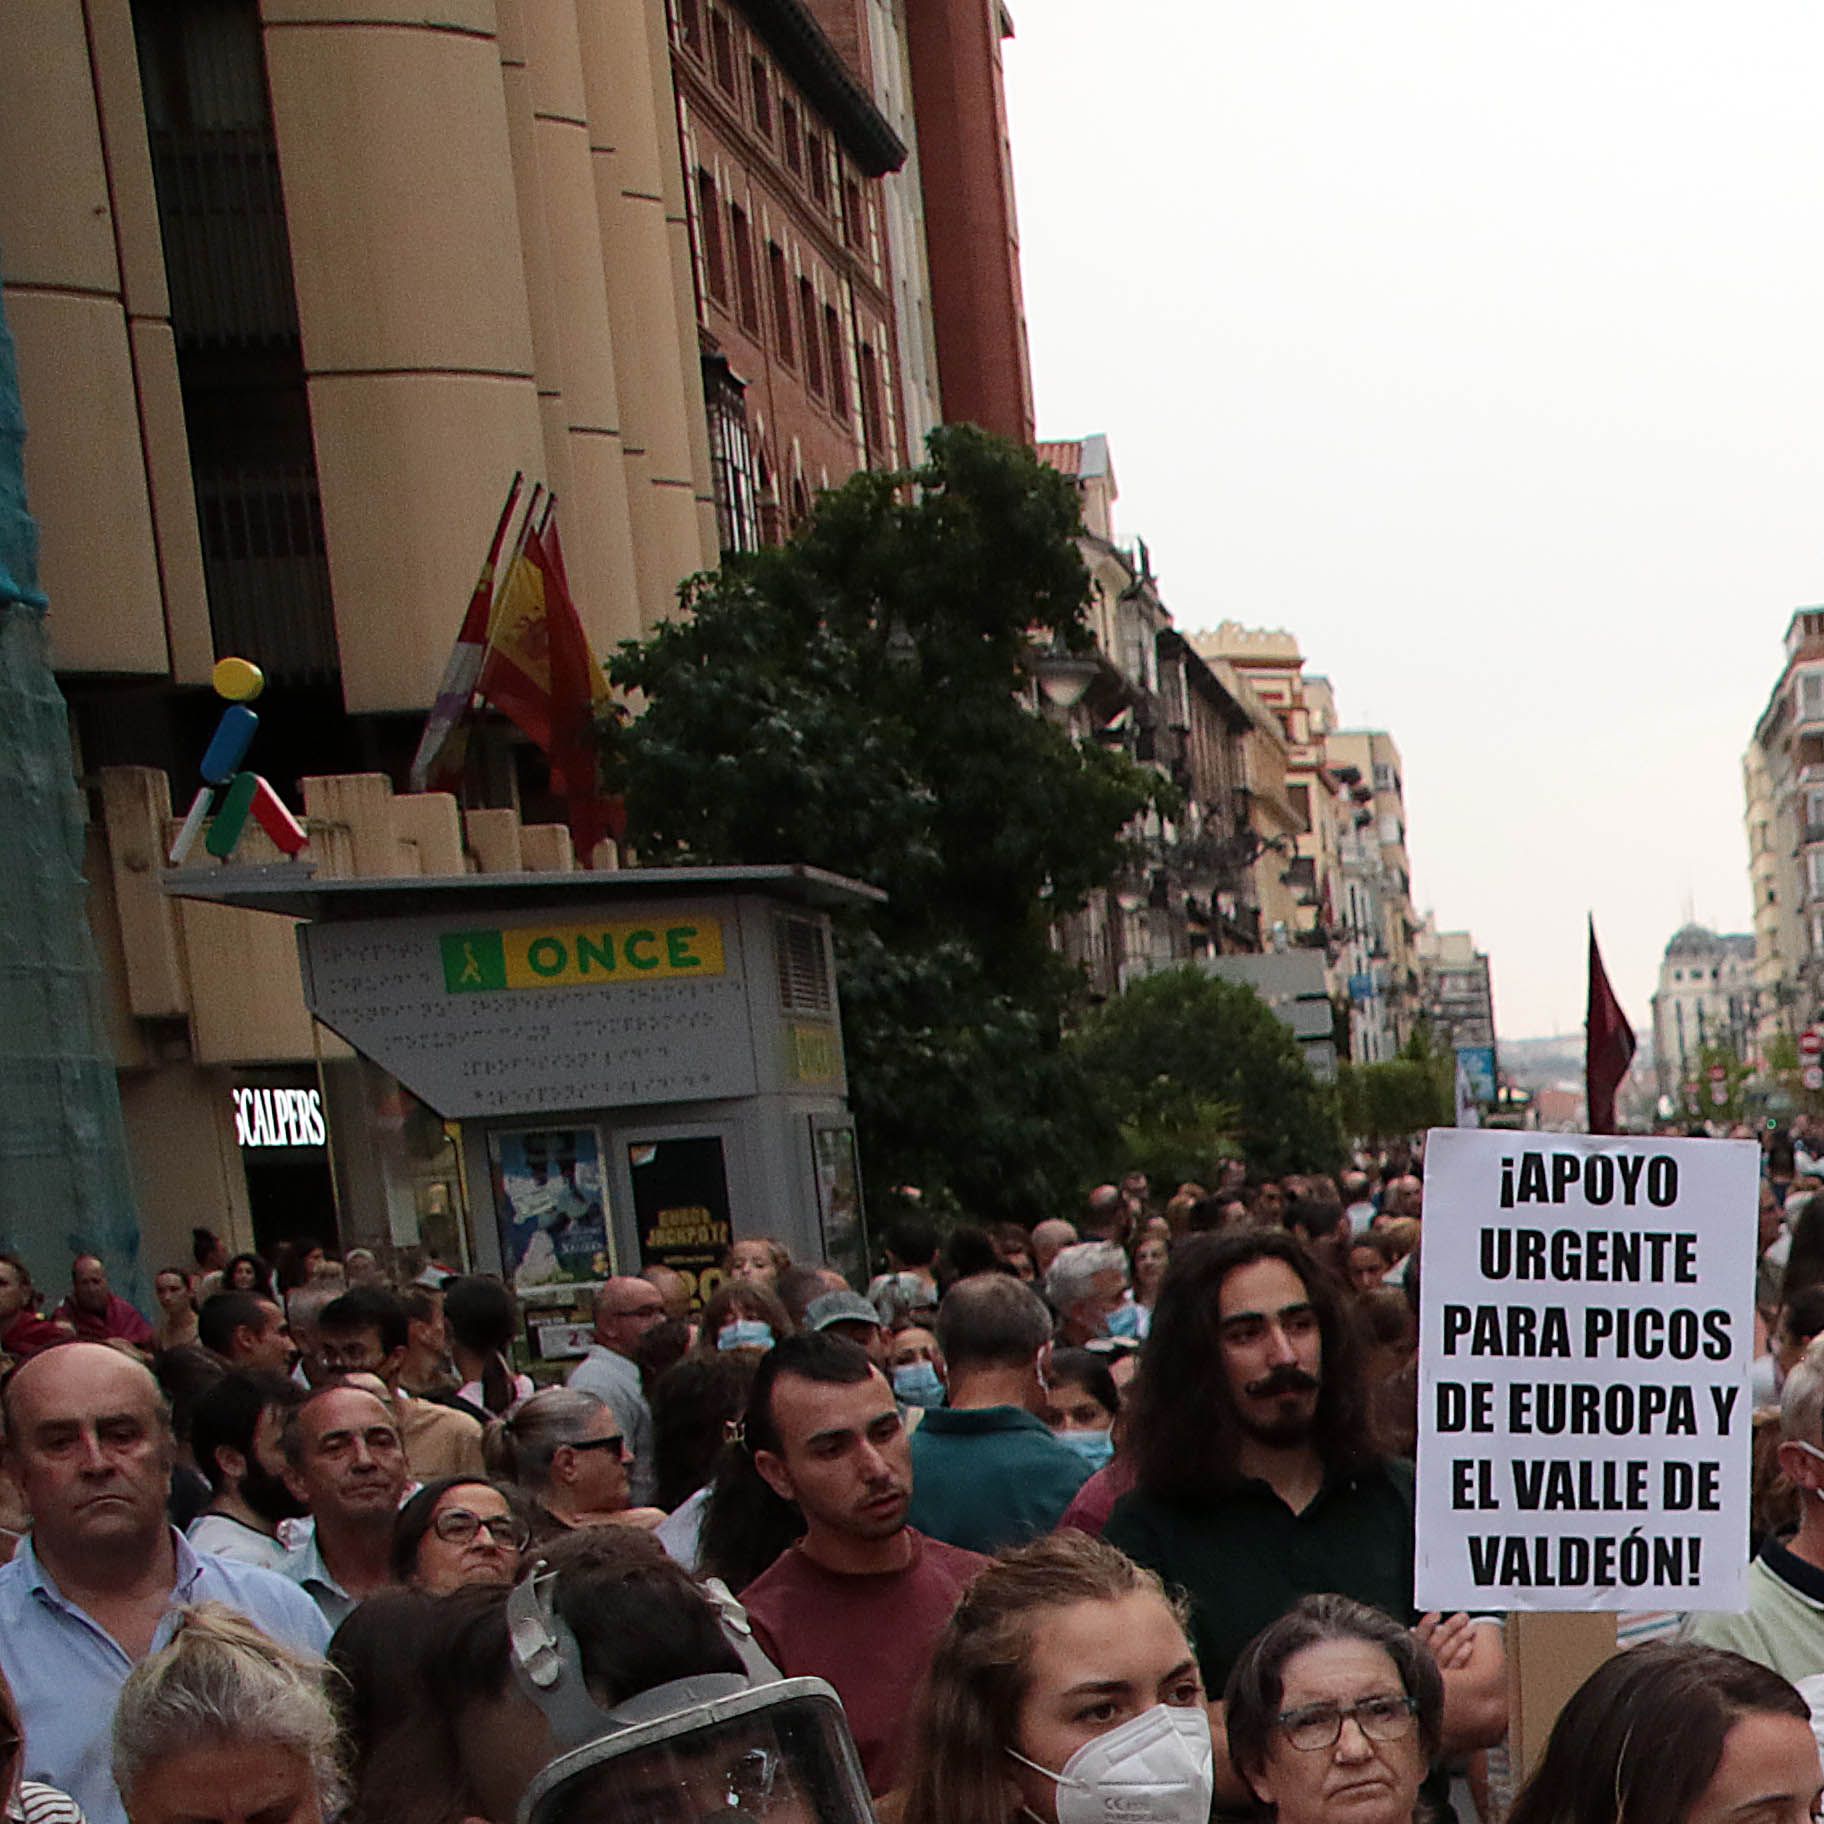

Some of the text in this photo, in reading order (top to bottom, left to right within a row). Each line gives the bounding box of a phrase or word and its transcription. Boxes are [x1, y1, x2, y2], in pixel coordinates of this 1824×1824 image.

[527, 926, 702, 977] ONCE
[1500, 1152, 1679, 1209] ¡APOYO
[1480, 1227, 1698, 1283] URGENTE
[1442, 1304, 1732, 1360] PARA PICOS
[1436, 1382, 1739, 1436] DE EUROPA Y
[1452, 1459, 1720, 1511] EL VALLE DE
[1468, 1526, 1702, 1587] VALDEÓN!
